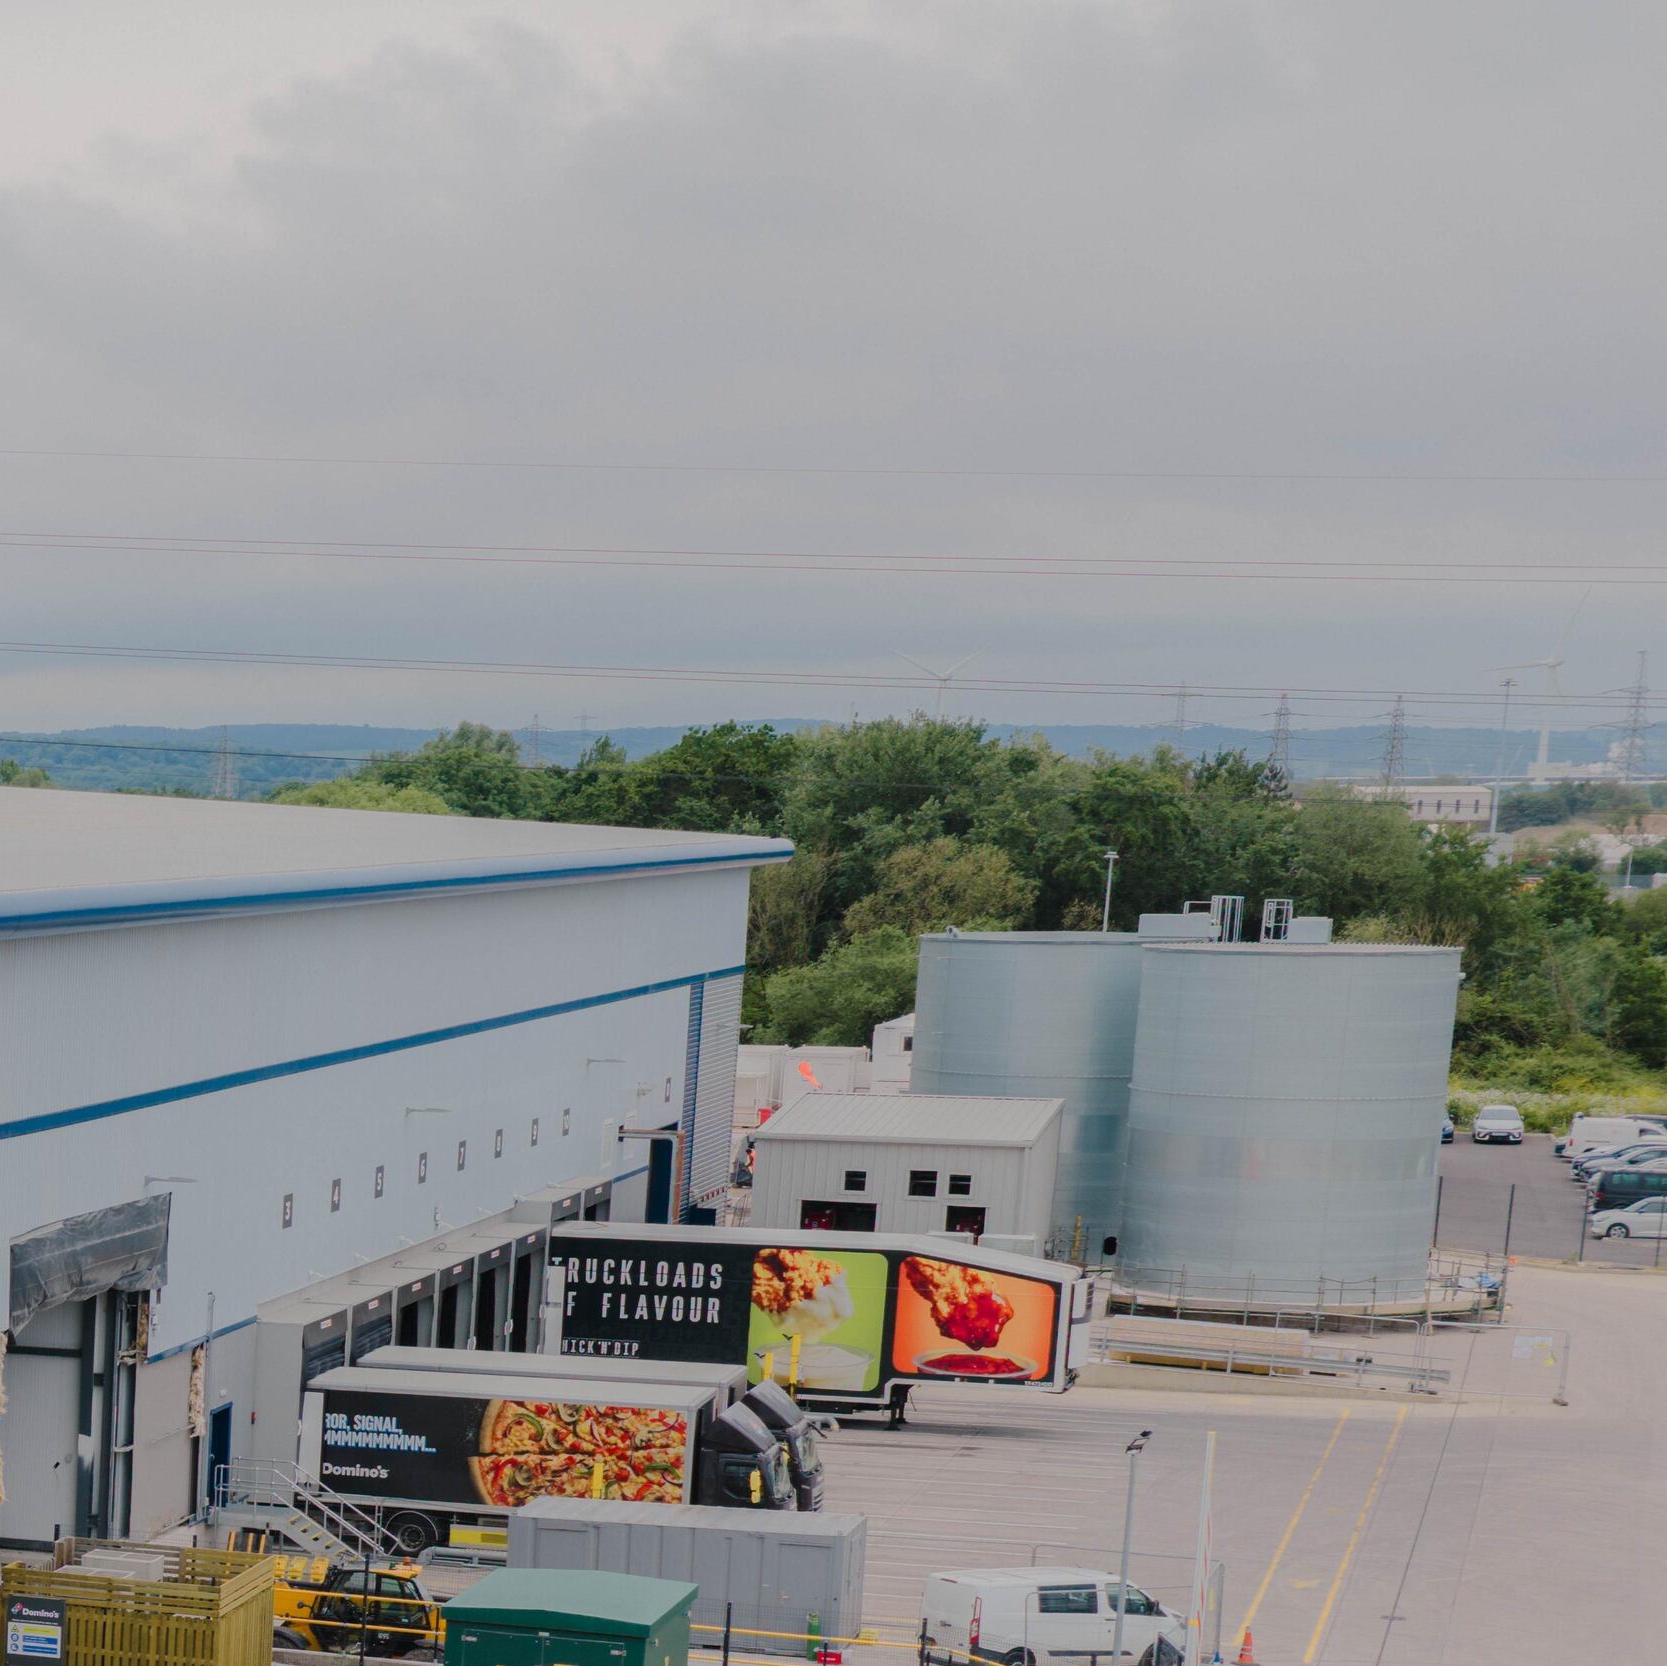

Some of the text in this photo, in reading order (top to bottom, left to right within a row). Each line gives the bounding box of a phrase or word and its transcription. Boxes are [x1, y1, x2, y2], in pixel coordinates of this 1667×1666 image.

[459, 1147, 465, 1164] 7
[419, 1159, 425, 1177] 6
[377, 1172, 383, 1191] 5
[333, 1185, 339, 1204] 4
[284, 1200, 291, 1220] 3
[601, 1292, 720, 1324] FLAVOUR
[353, 1414, 403, 1435] SIGNAL,
[322, 1462, 390, 1479] Domino's
[22, 1607, 60, 1619] Domino's
